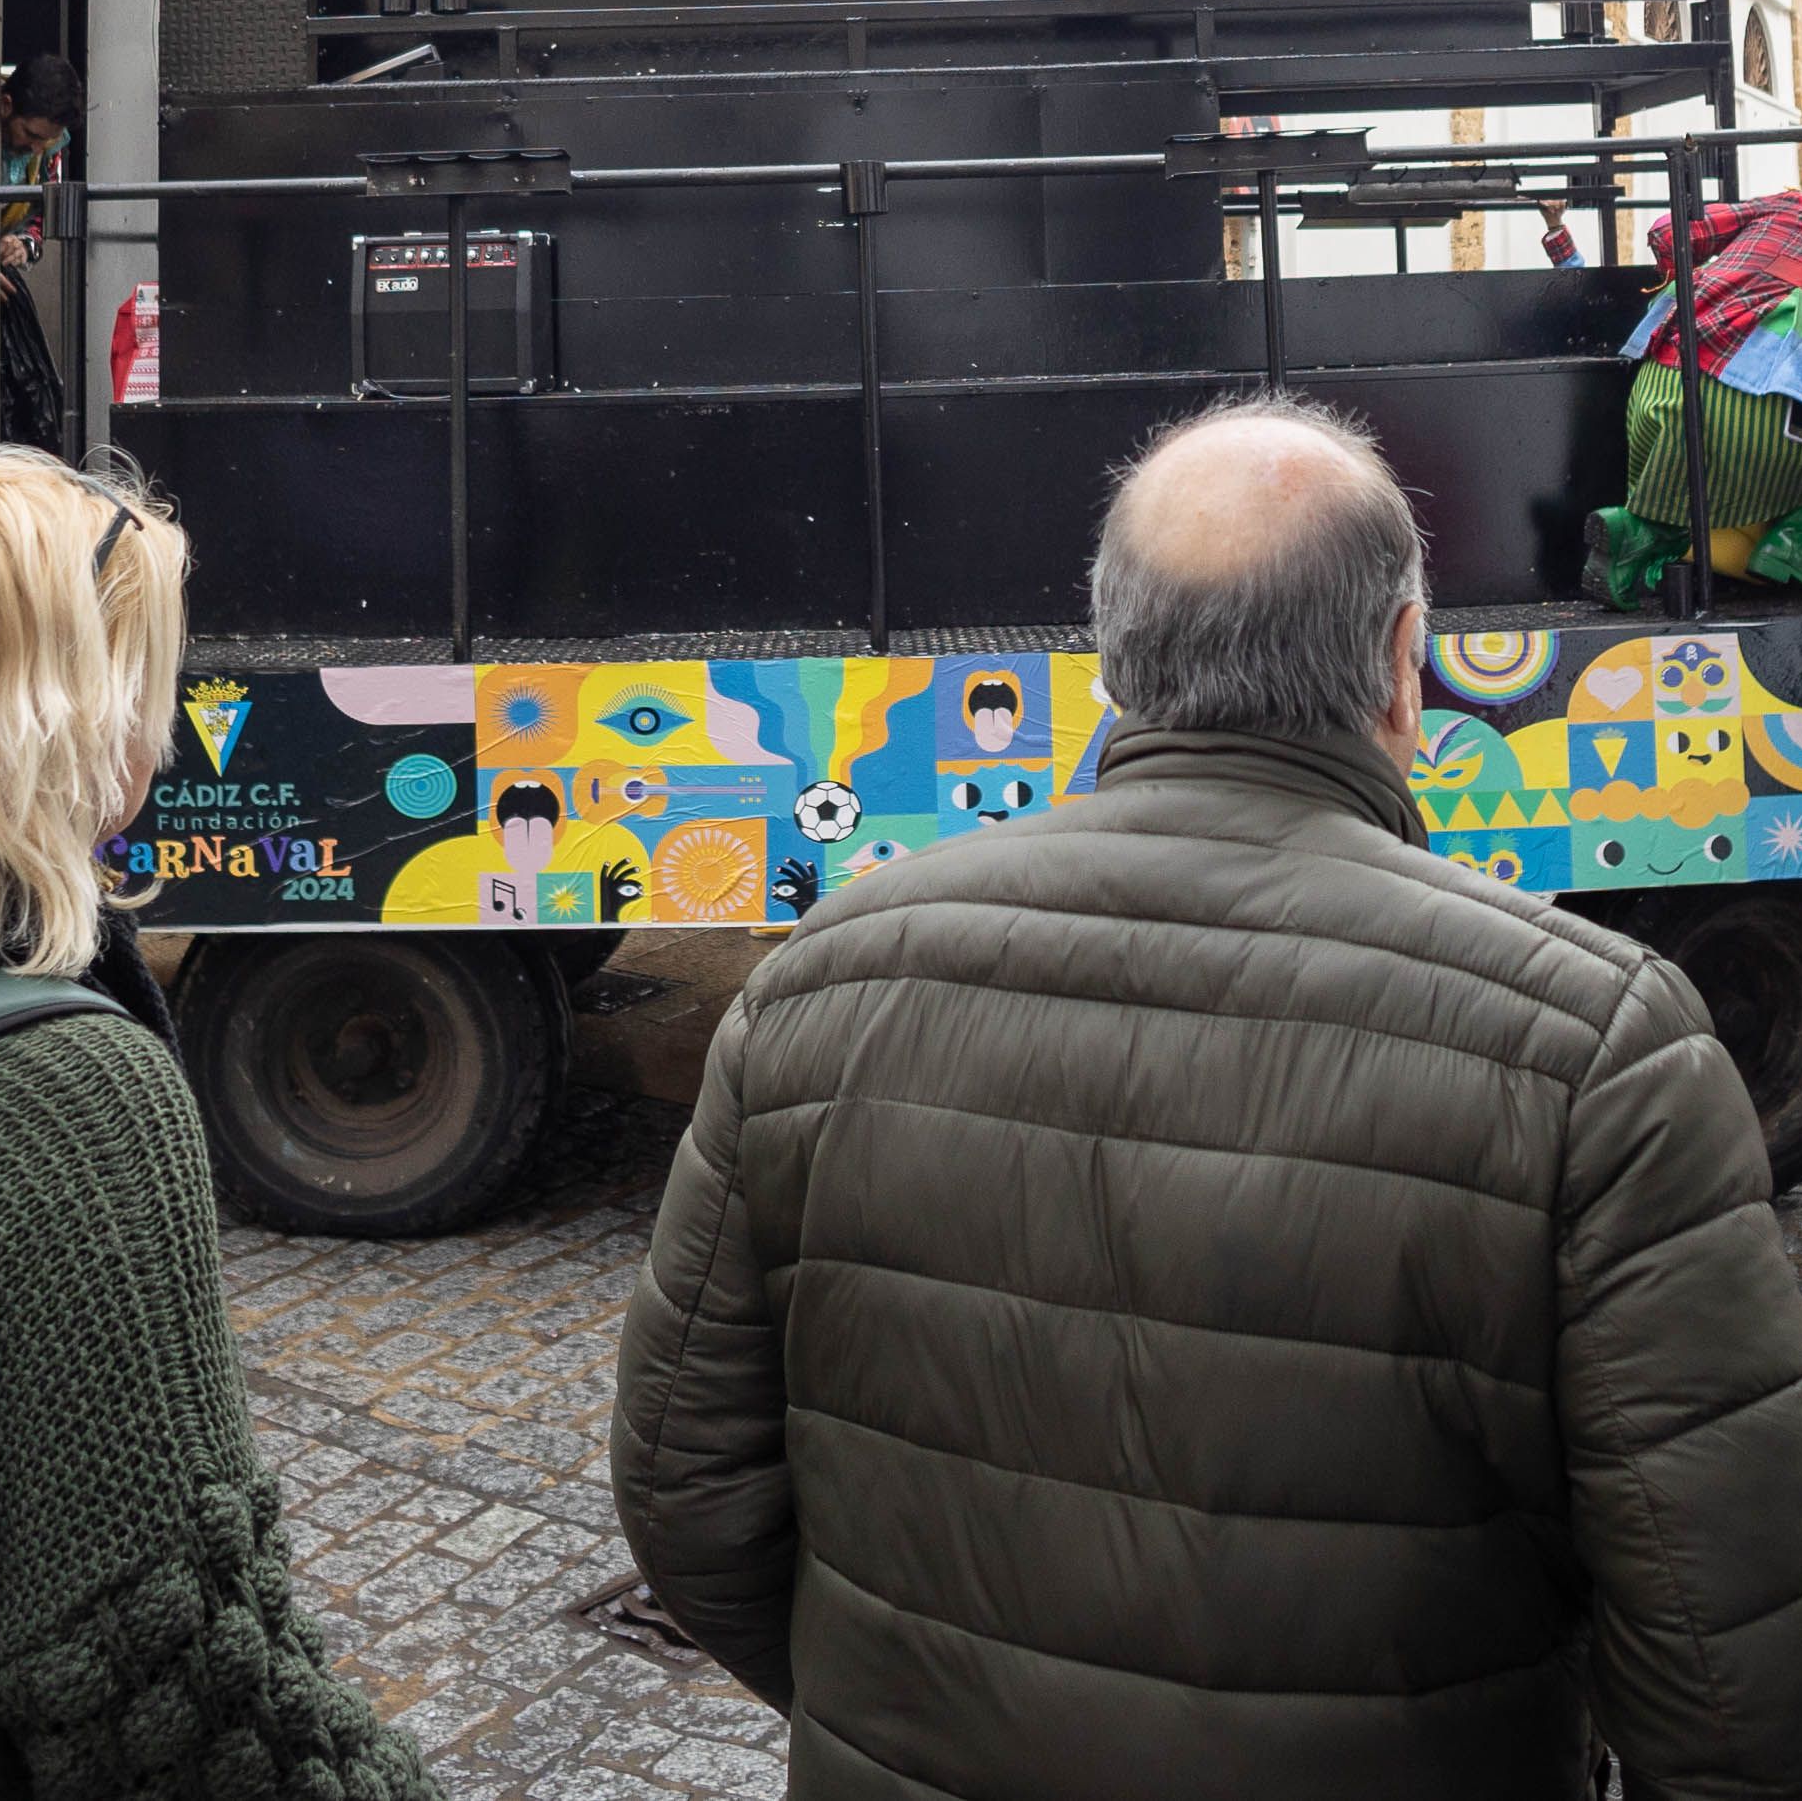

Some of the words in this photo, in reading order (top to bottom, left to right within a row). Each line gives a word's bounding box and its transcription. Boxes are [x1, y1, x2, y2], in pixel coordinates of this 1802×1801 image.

[377, 280, 390, 291] EK
[154, 778, 243, 808] CÁDIZ
[250, 784, 301, 806] C.F.
[157, 811, 299, 830] Fundación
[282, 878, 355, 900] 2024
